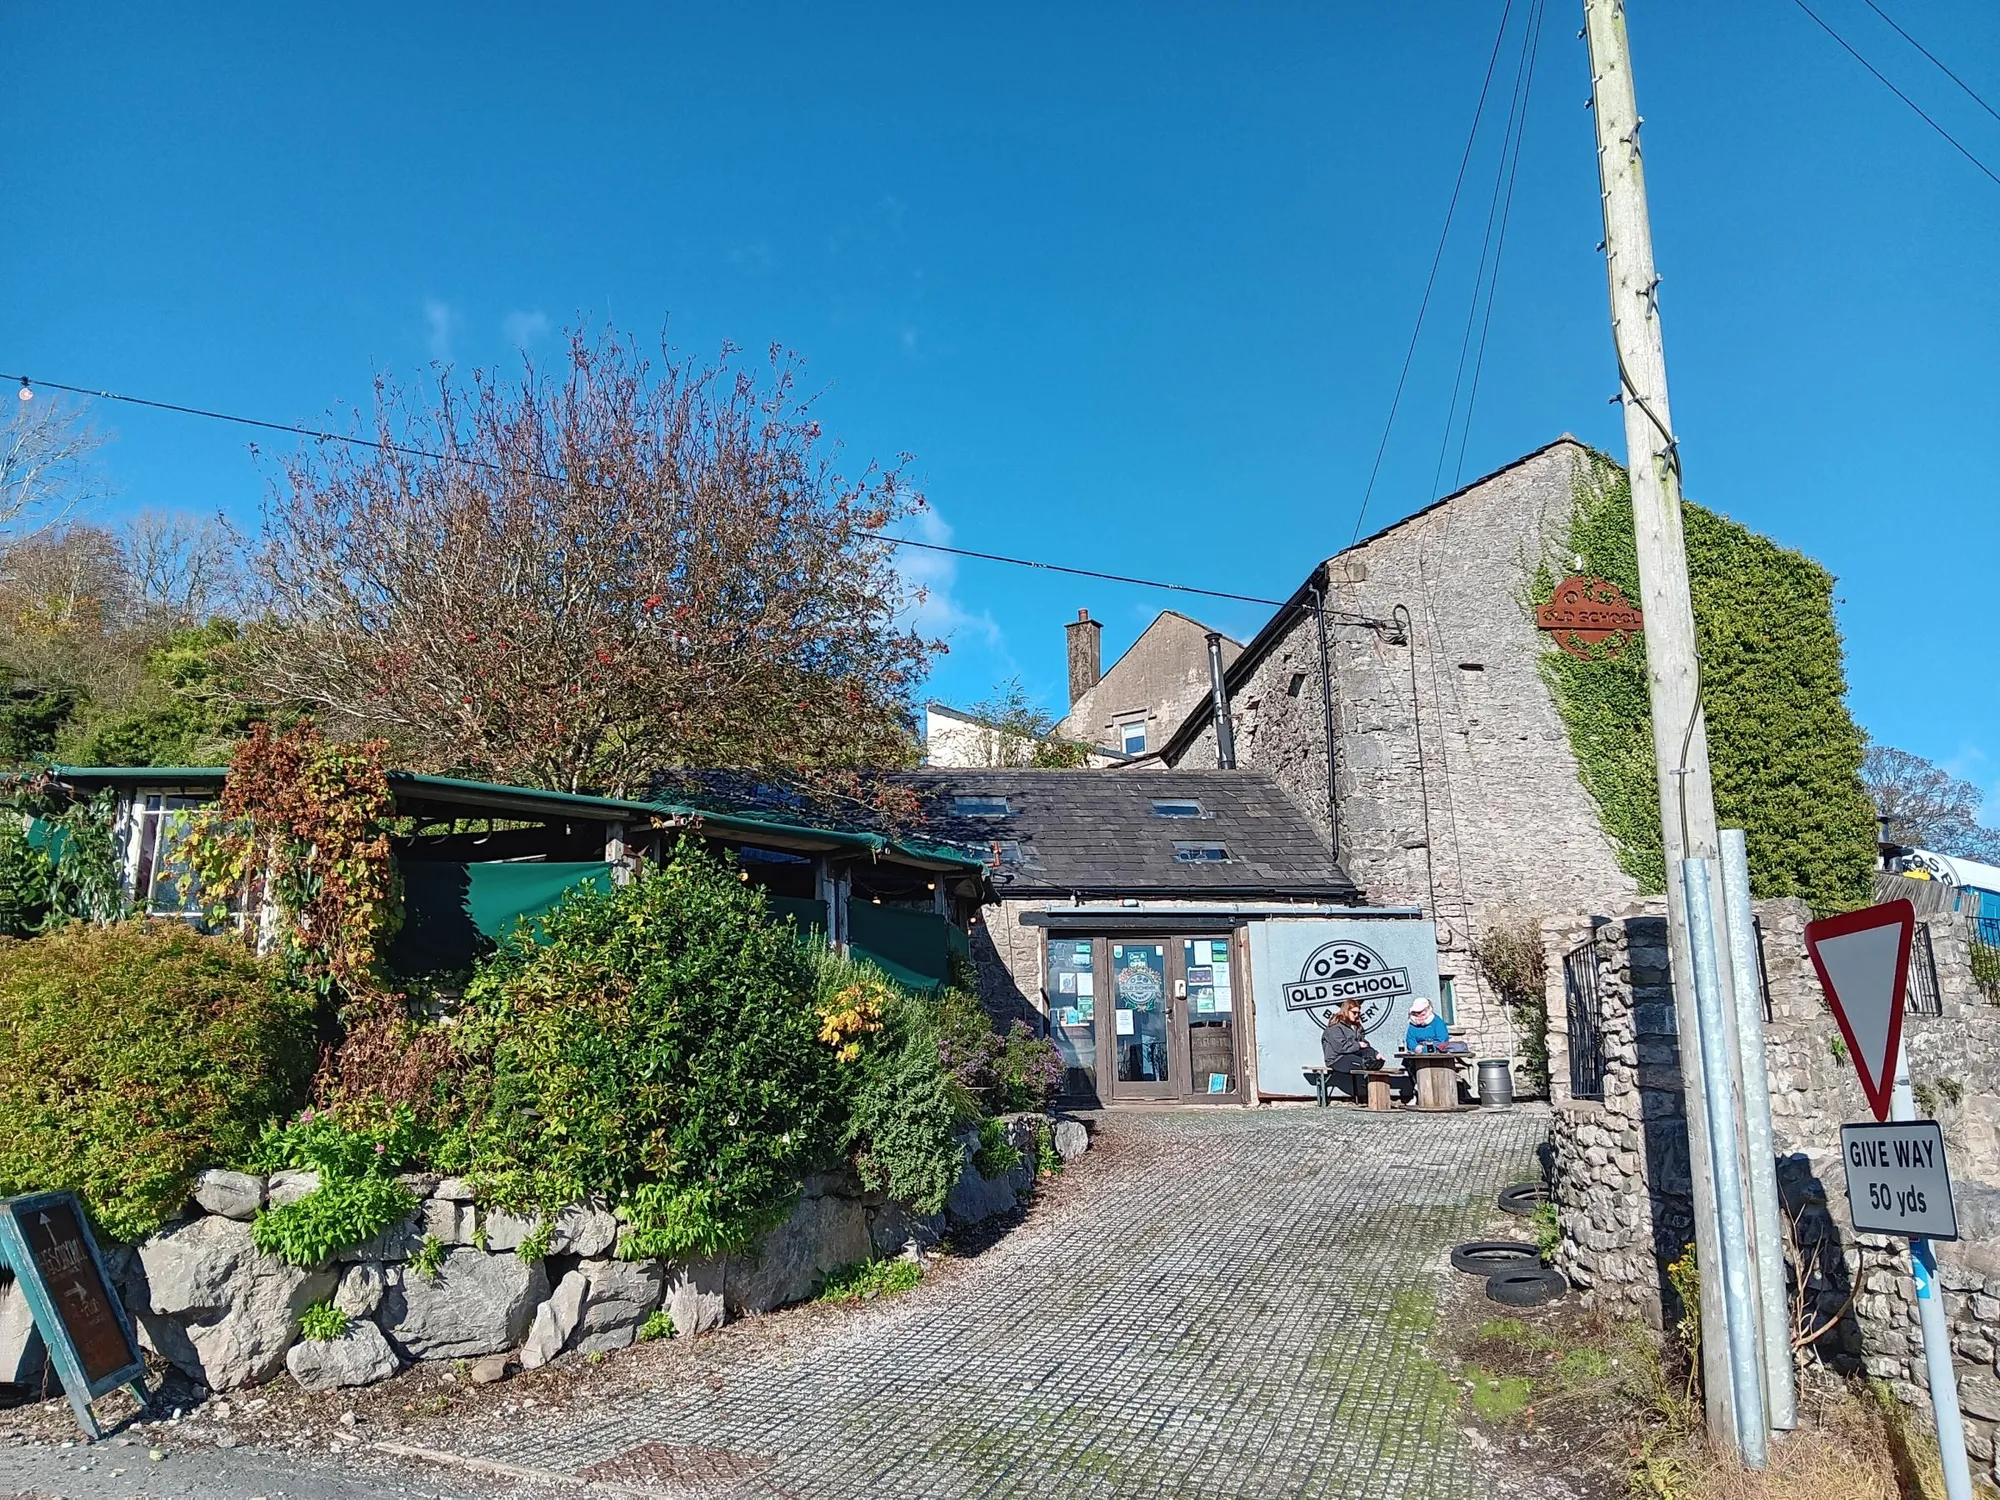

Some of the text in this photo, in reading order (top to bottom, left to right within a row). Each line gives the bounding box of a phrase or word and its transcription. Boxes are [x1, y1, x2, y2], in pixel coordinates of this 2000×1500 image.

[1578, 611, 1641, 624] SCHOOL
[1291, 975, 1404, 1002] OLD SCHOOL
[1850, 1140, 1934, 1168] GIVE WAY
[1869, 1183, 1927, 1217] 50 yds
